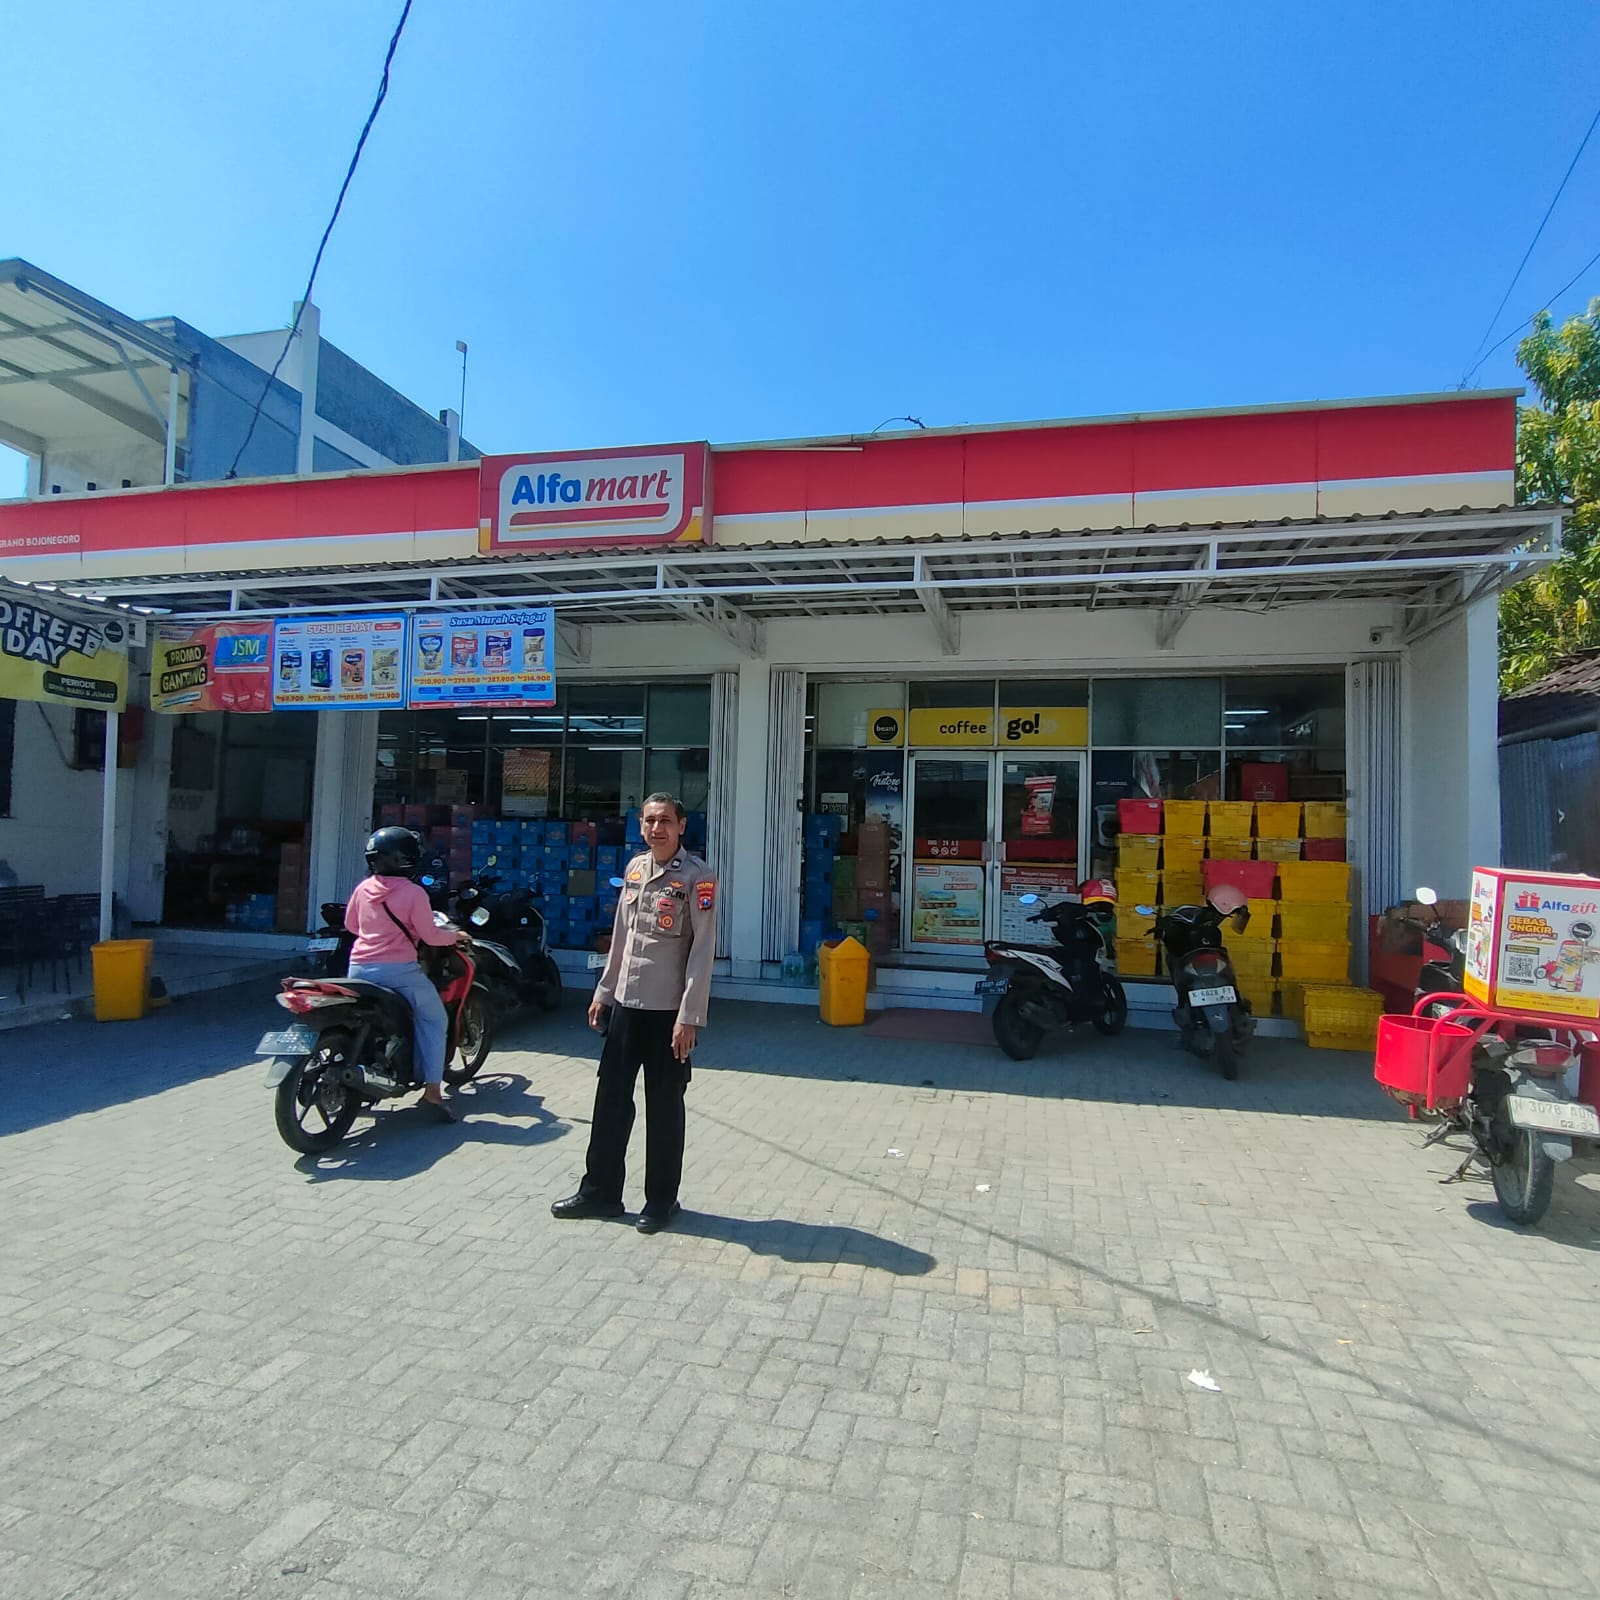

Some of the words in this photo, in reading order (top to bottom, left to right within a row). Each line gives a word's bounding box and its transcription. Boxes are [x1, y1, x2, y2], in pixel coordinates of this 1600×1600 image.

[511, 469, 673, 506] Alfamart
[26, 534, 81, 546] BOJONEGORO
[450, 616, 475, 627] Susu
[475, 614, 509, 626] Murah
[510, 612, 546, 626] Sejagat
[306, 624, 335, 634] SUSU
[336, 622, 372, 633] HEMAT
[6, 628, 66, 665] DAY
[231, 639, 261, 656] JSM
[170, 646, 202, 665] PROMO
[939, 720, 987, 734] coffee
[1006, 713, 1041, 740] go!
[658, 888, 686, 900] POLRI
[1541, 900, 1599, 915] Alfagift
[1508, 915, 1547, 926] BEBAS
[1508, 923, 1552, 934] ONGKIR
